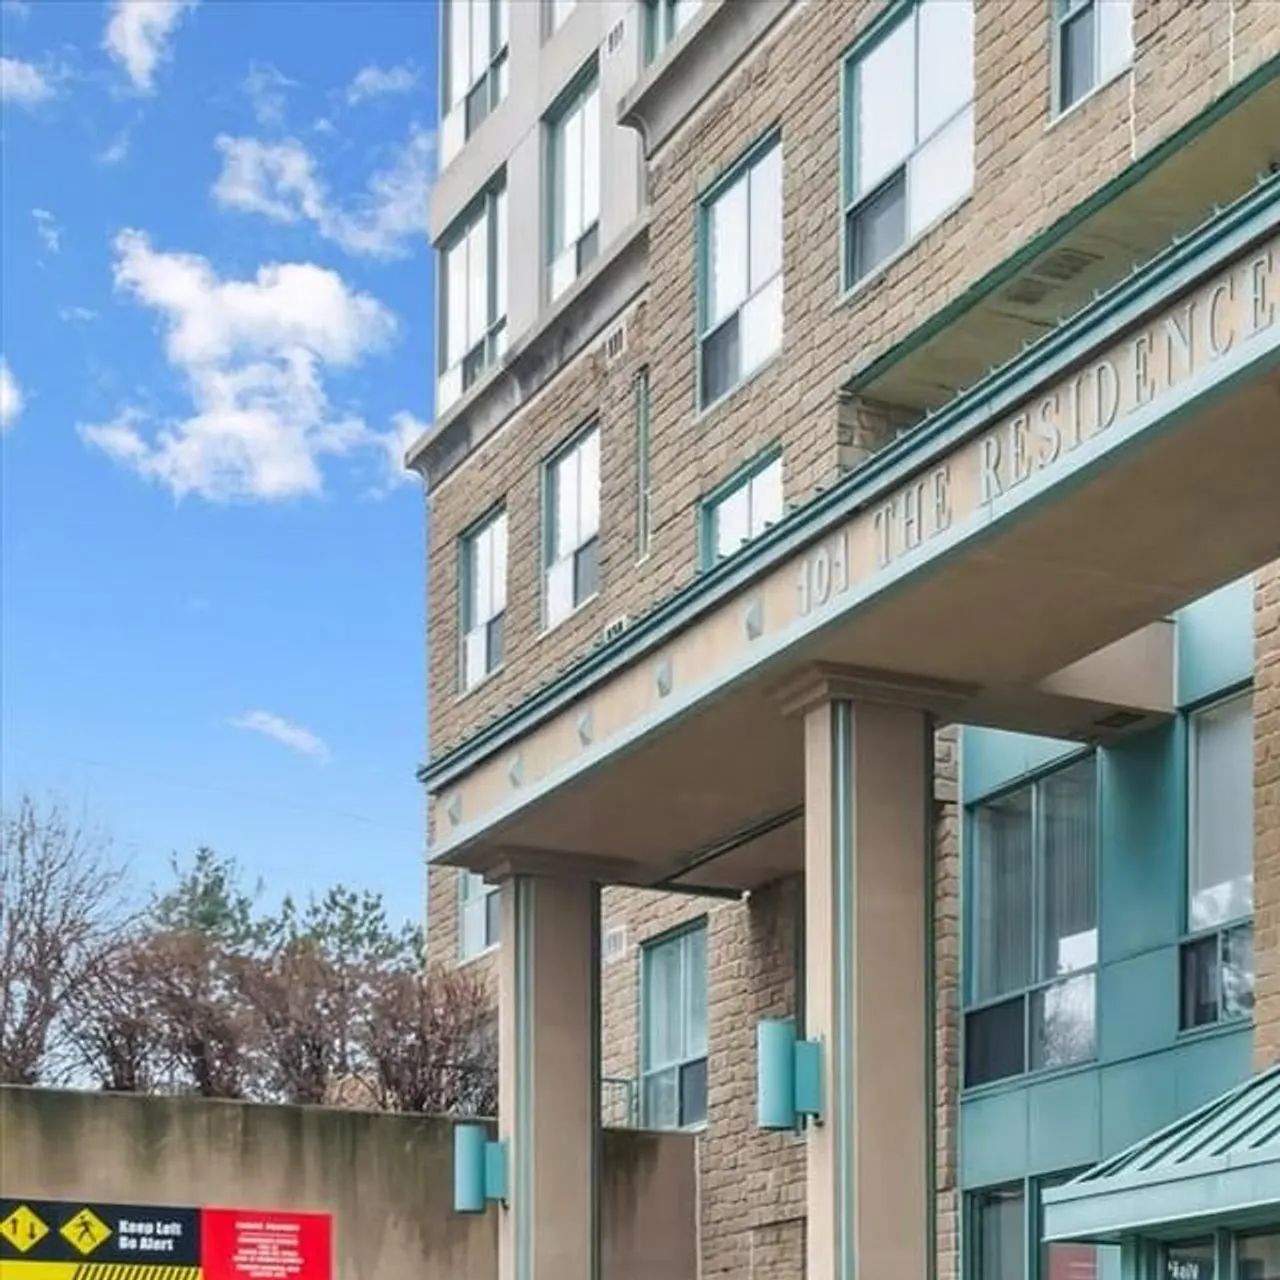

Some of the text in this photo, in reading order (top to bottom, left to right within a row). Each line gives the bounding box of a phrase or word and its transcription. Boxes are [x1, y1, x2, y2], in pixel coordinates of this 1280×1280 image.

[797, 531, 850, 617] 101
[874, 465, 953, 570] THE
[118, 1219, 182, 1236] Keep Left
[118, 1235, 174, 1252] Be Alert
